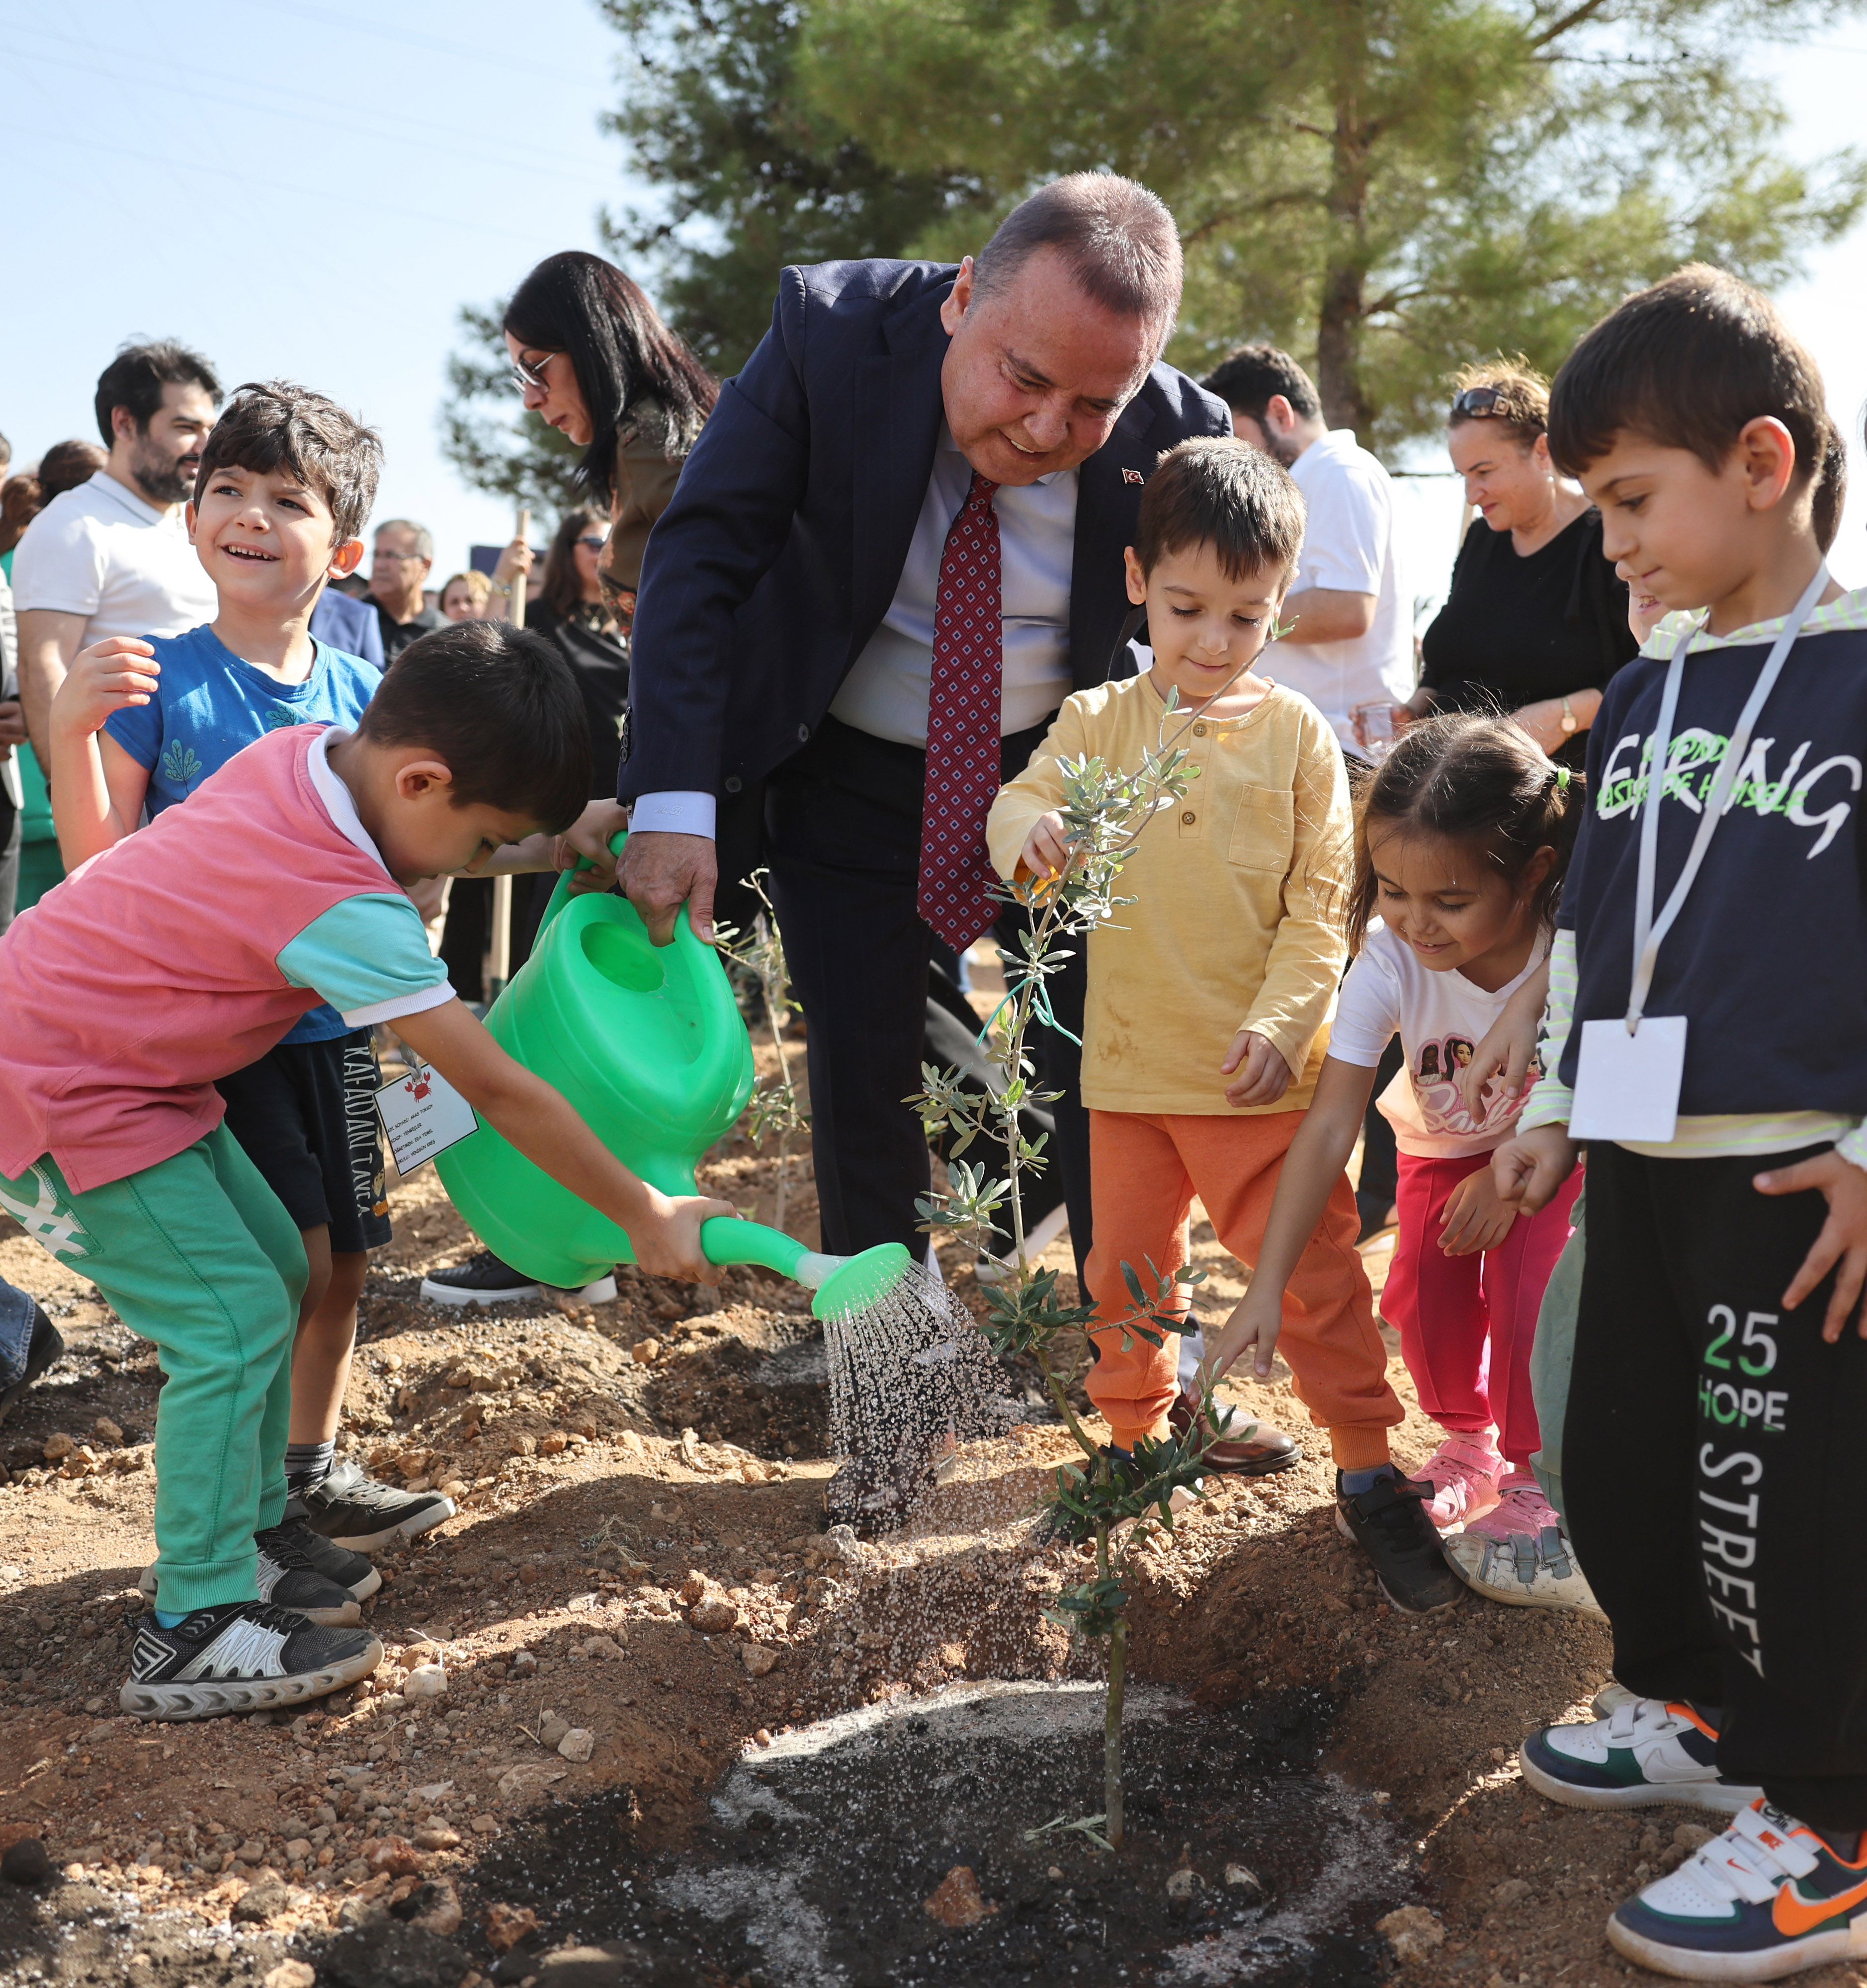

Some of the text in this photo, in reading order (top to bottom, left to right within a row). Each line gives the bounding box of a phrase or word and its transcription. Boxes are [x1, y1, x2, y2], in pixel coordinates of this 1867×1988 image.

[395, 1118, 410, 1129] SOYADI:
[1704, 1304, 1780, 1376] 25
[1697, 1374, 1789, 1432] HOPE
